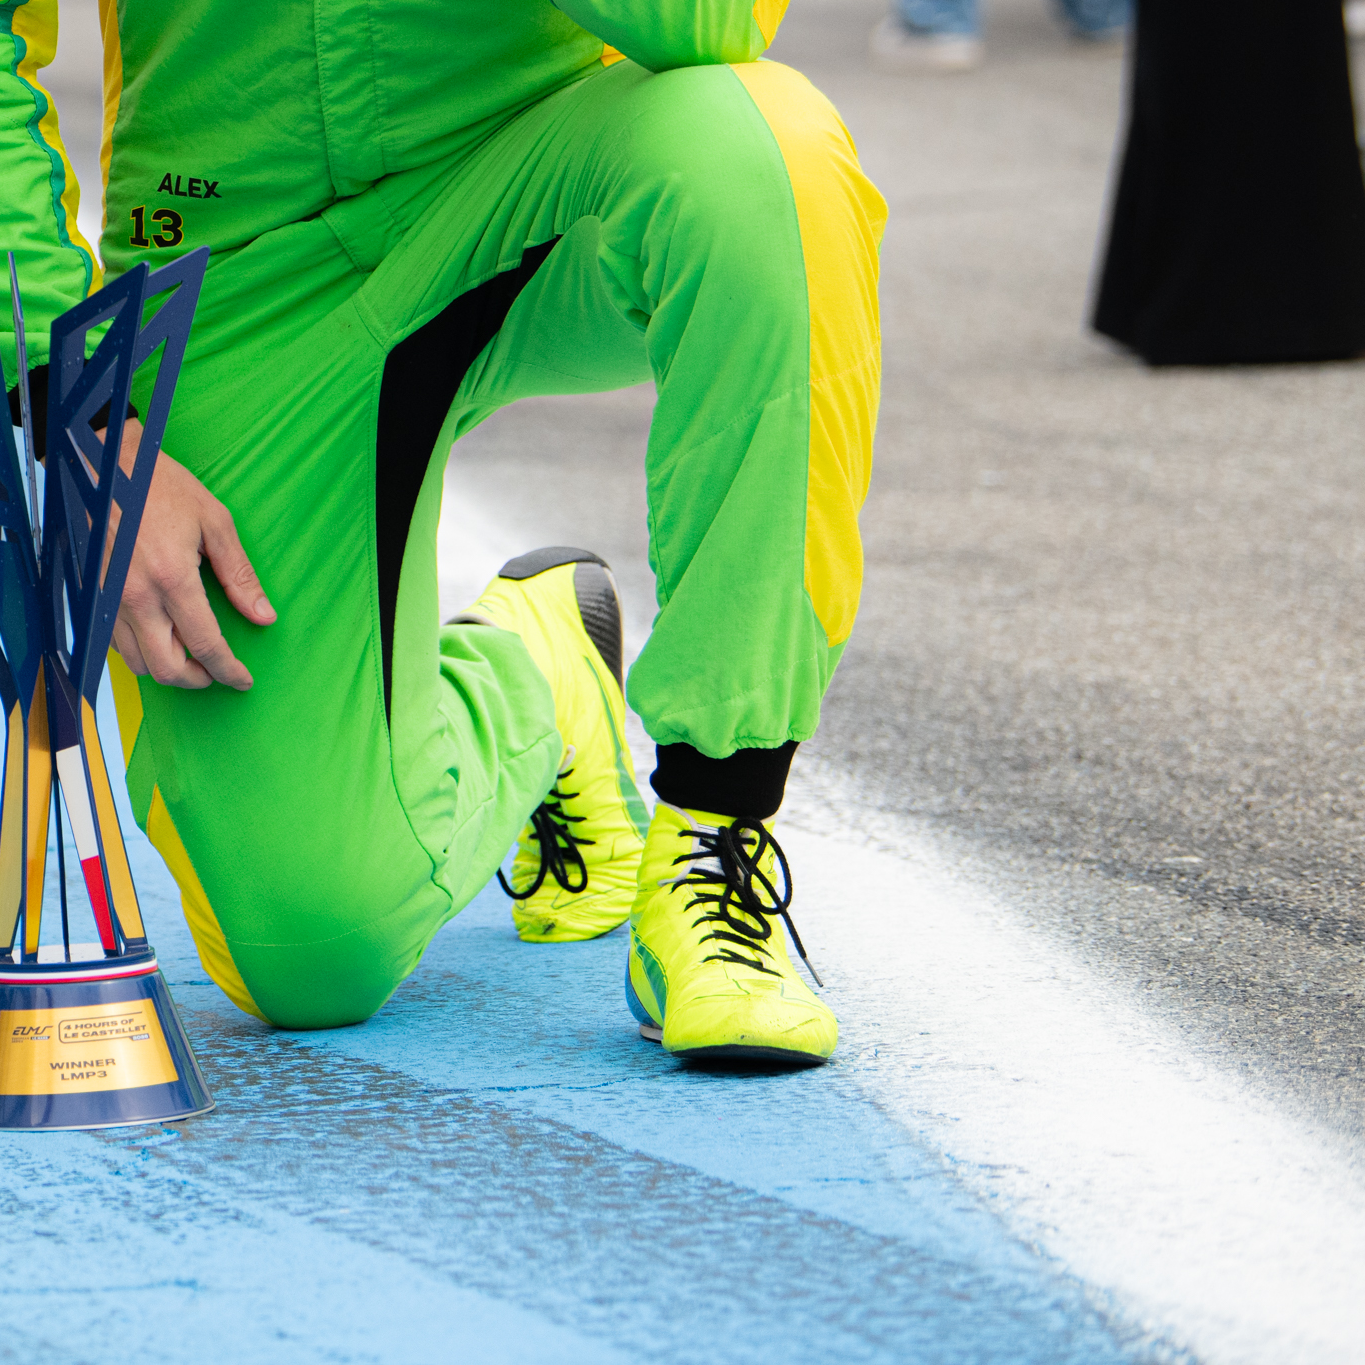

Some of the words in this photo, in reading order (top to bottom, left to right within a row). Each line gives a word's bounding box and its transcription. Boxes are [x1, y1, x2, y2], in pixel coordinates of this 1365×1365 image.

[157, 172, 222, 198] ALEX
[130, 204, 184, 248] 13
[12, 1026, 53, 1035] ELMS
[75, 1020, 118, 1029] HOURS
[82, 1025, 146, 1038] CASTELLET
[50, 1058, 116, 1070] WINNER
[61, 1071, 107, 1081] LMP3
